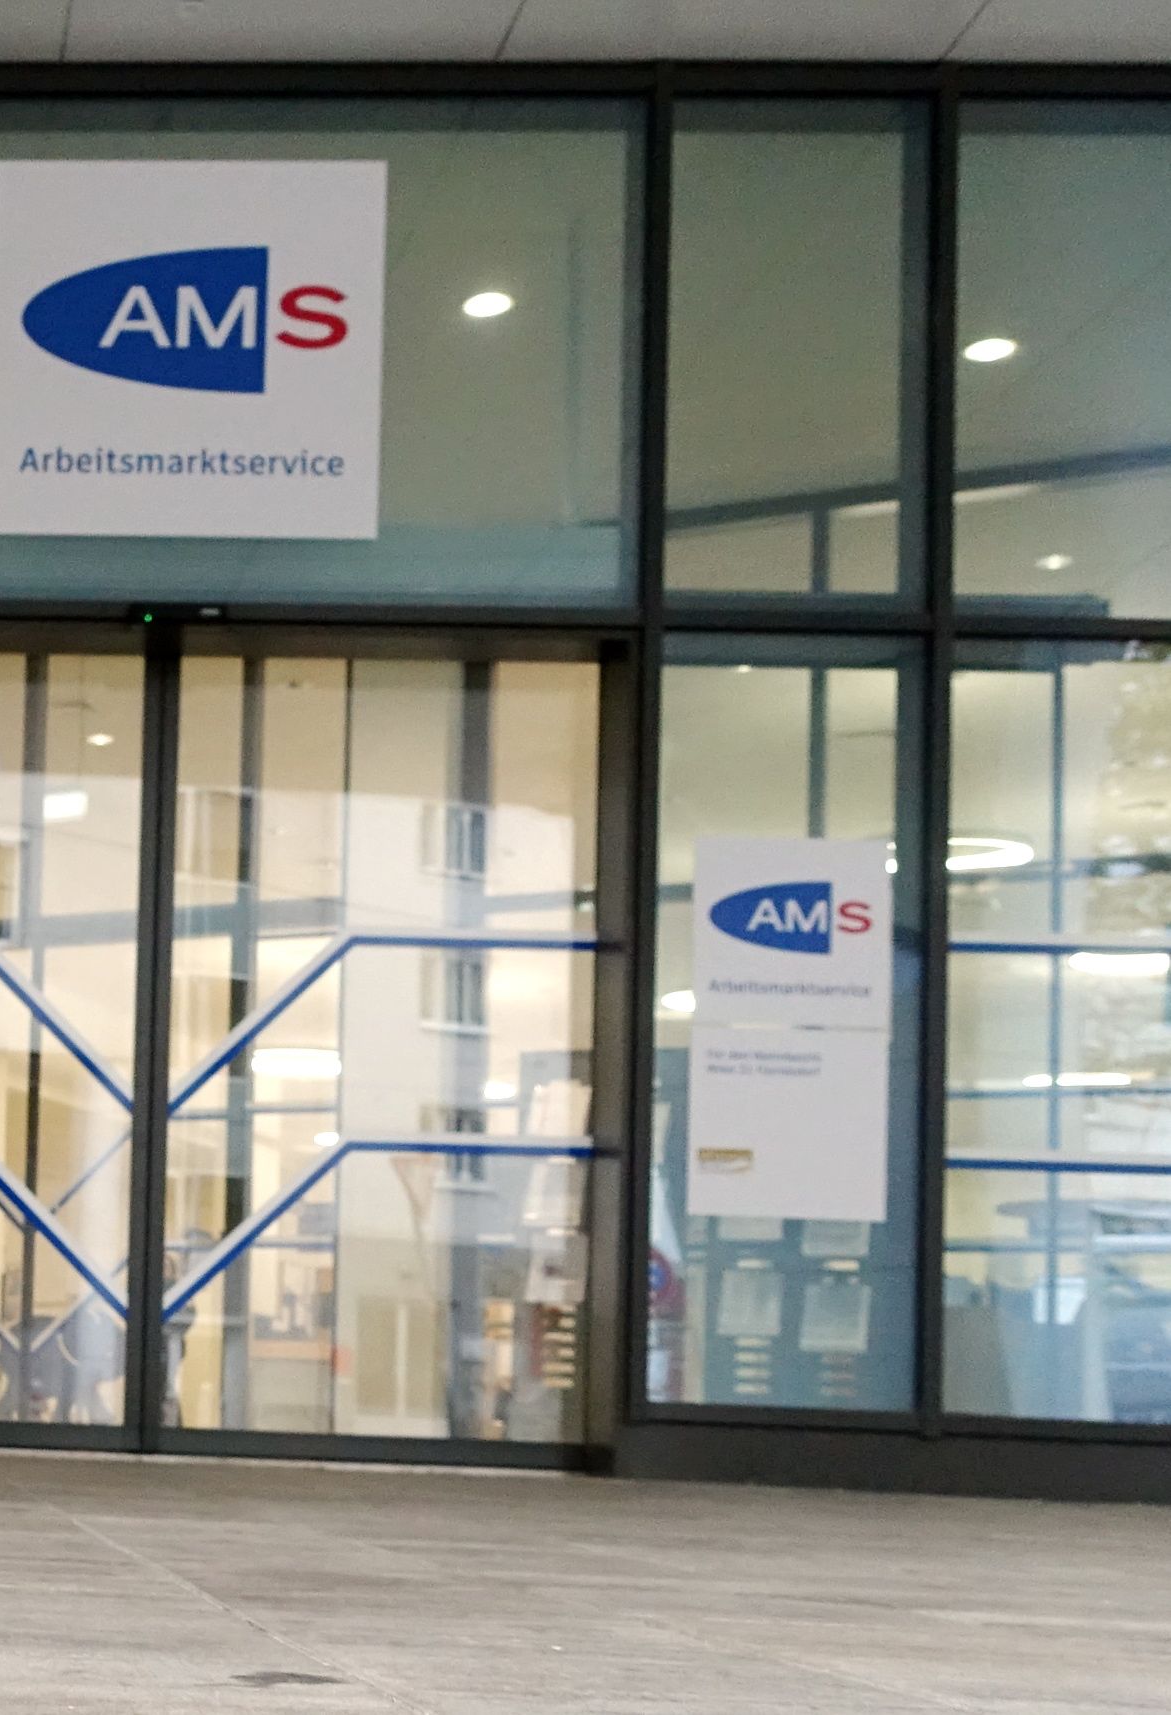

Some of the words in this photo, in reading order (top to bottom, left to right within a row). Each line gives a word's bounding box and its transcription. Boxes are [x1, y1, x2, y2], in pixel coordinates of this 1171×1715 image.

[98, 285, 348, 350] AMS
[19, 446, 345, 478] Arbeitsmarktservice
[746, 898, 872, 935] AMS
